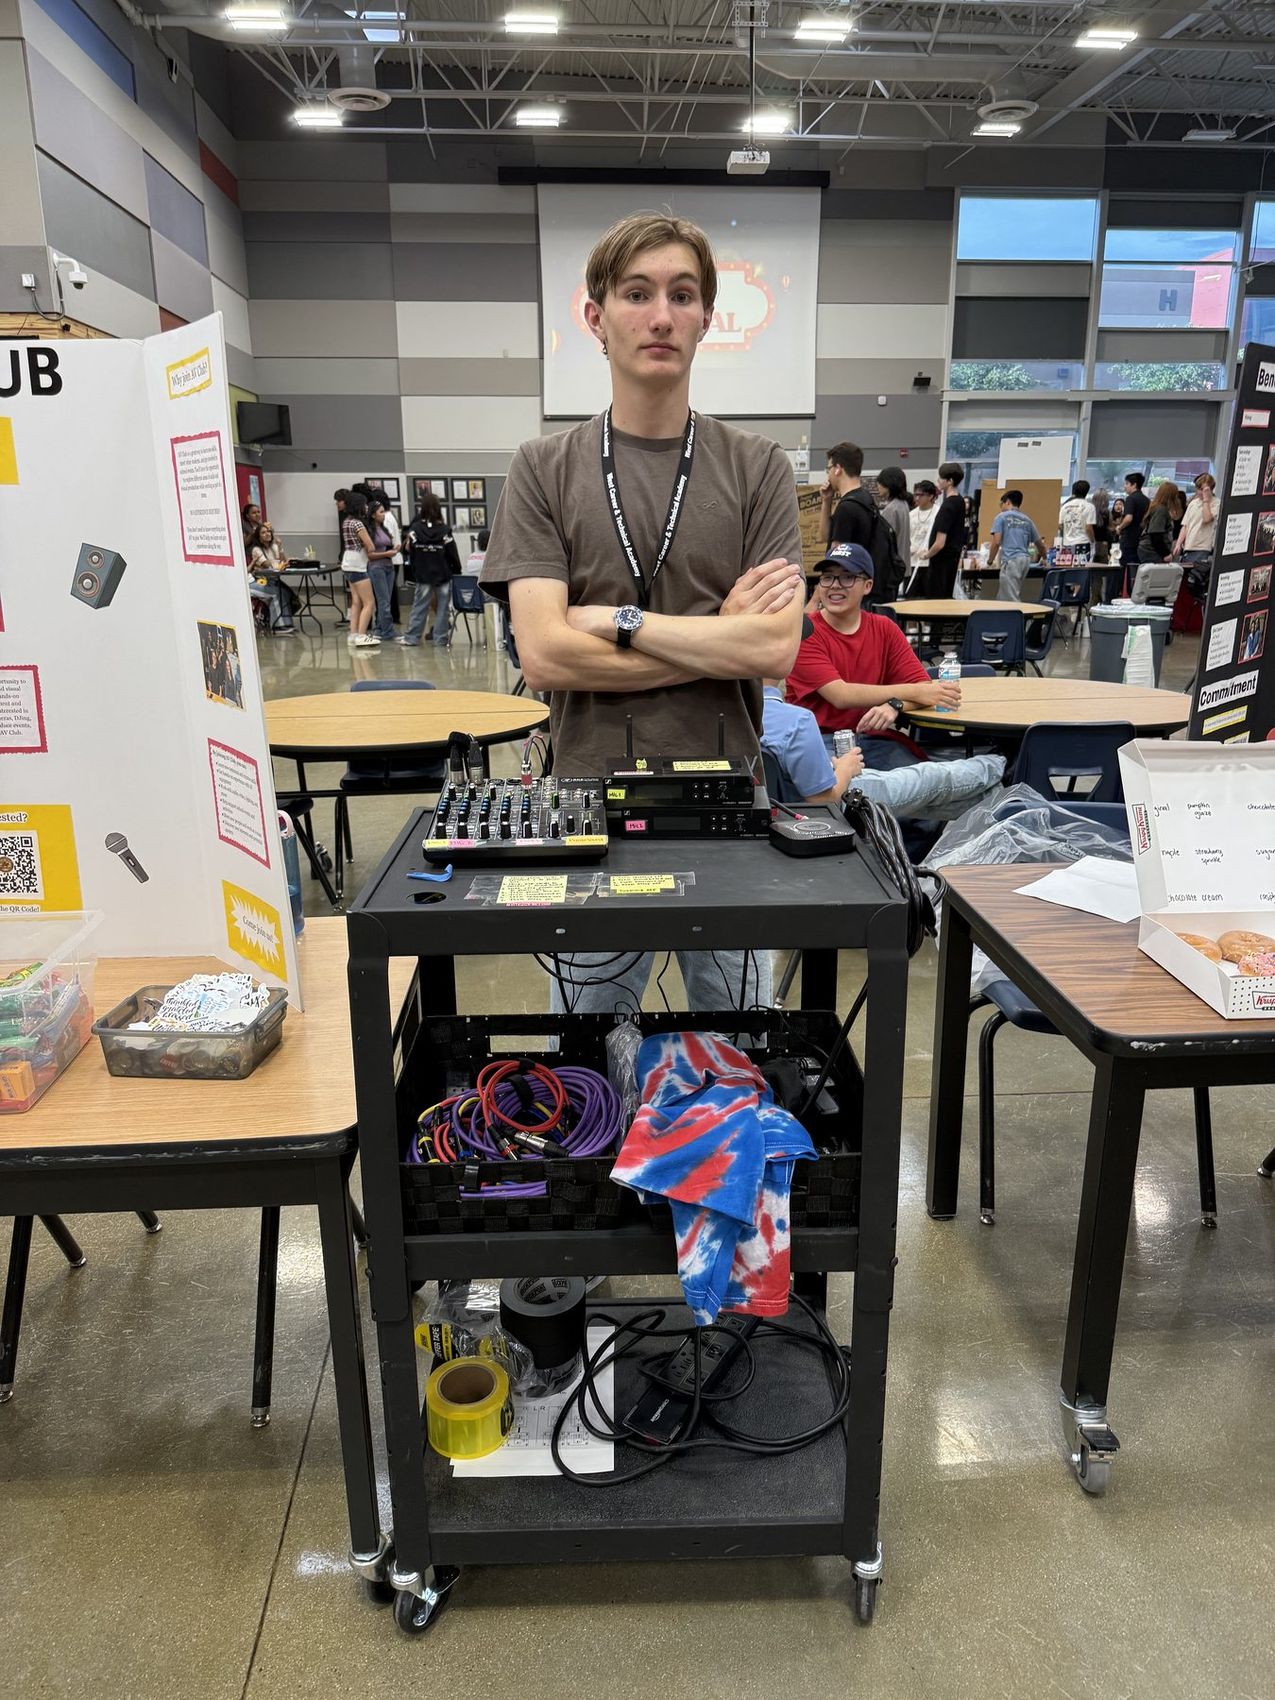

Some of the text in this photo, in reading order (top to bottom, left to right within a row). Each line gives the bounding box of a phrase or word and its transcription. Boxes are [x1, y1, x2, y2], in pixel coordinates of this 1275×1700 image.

[1159, 289, 1178, 311] H
[1258, 368, 1275, 388] Ben
[606, 472, 615, 489] West
[609, 488, 619, 509] Career
[658, 537, 670, 561] Career
[666, 501, 680, 531] Technical
[673, 474, 688, 502] Academy
[615, 515, 631, 547] Technical
[625, 547, 641, 577] Academy
[1200, 674, 1258, 707] Commitment
[9, 905, 20, 915] QR
